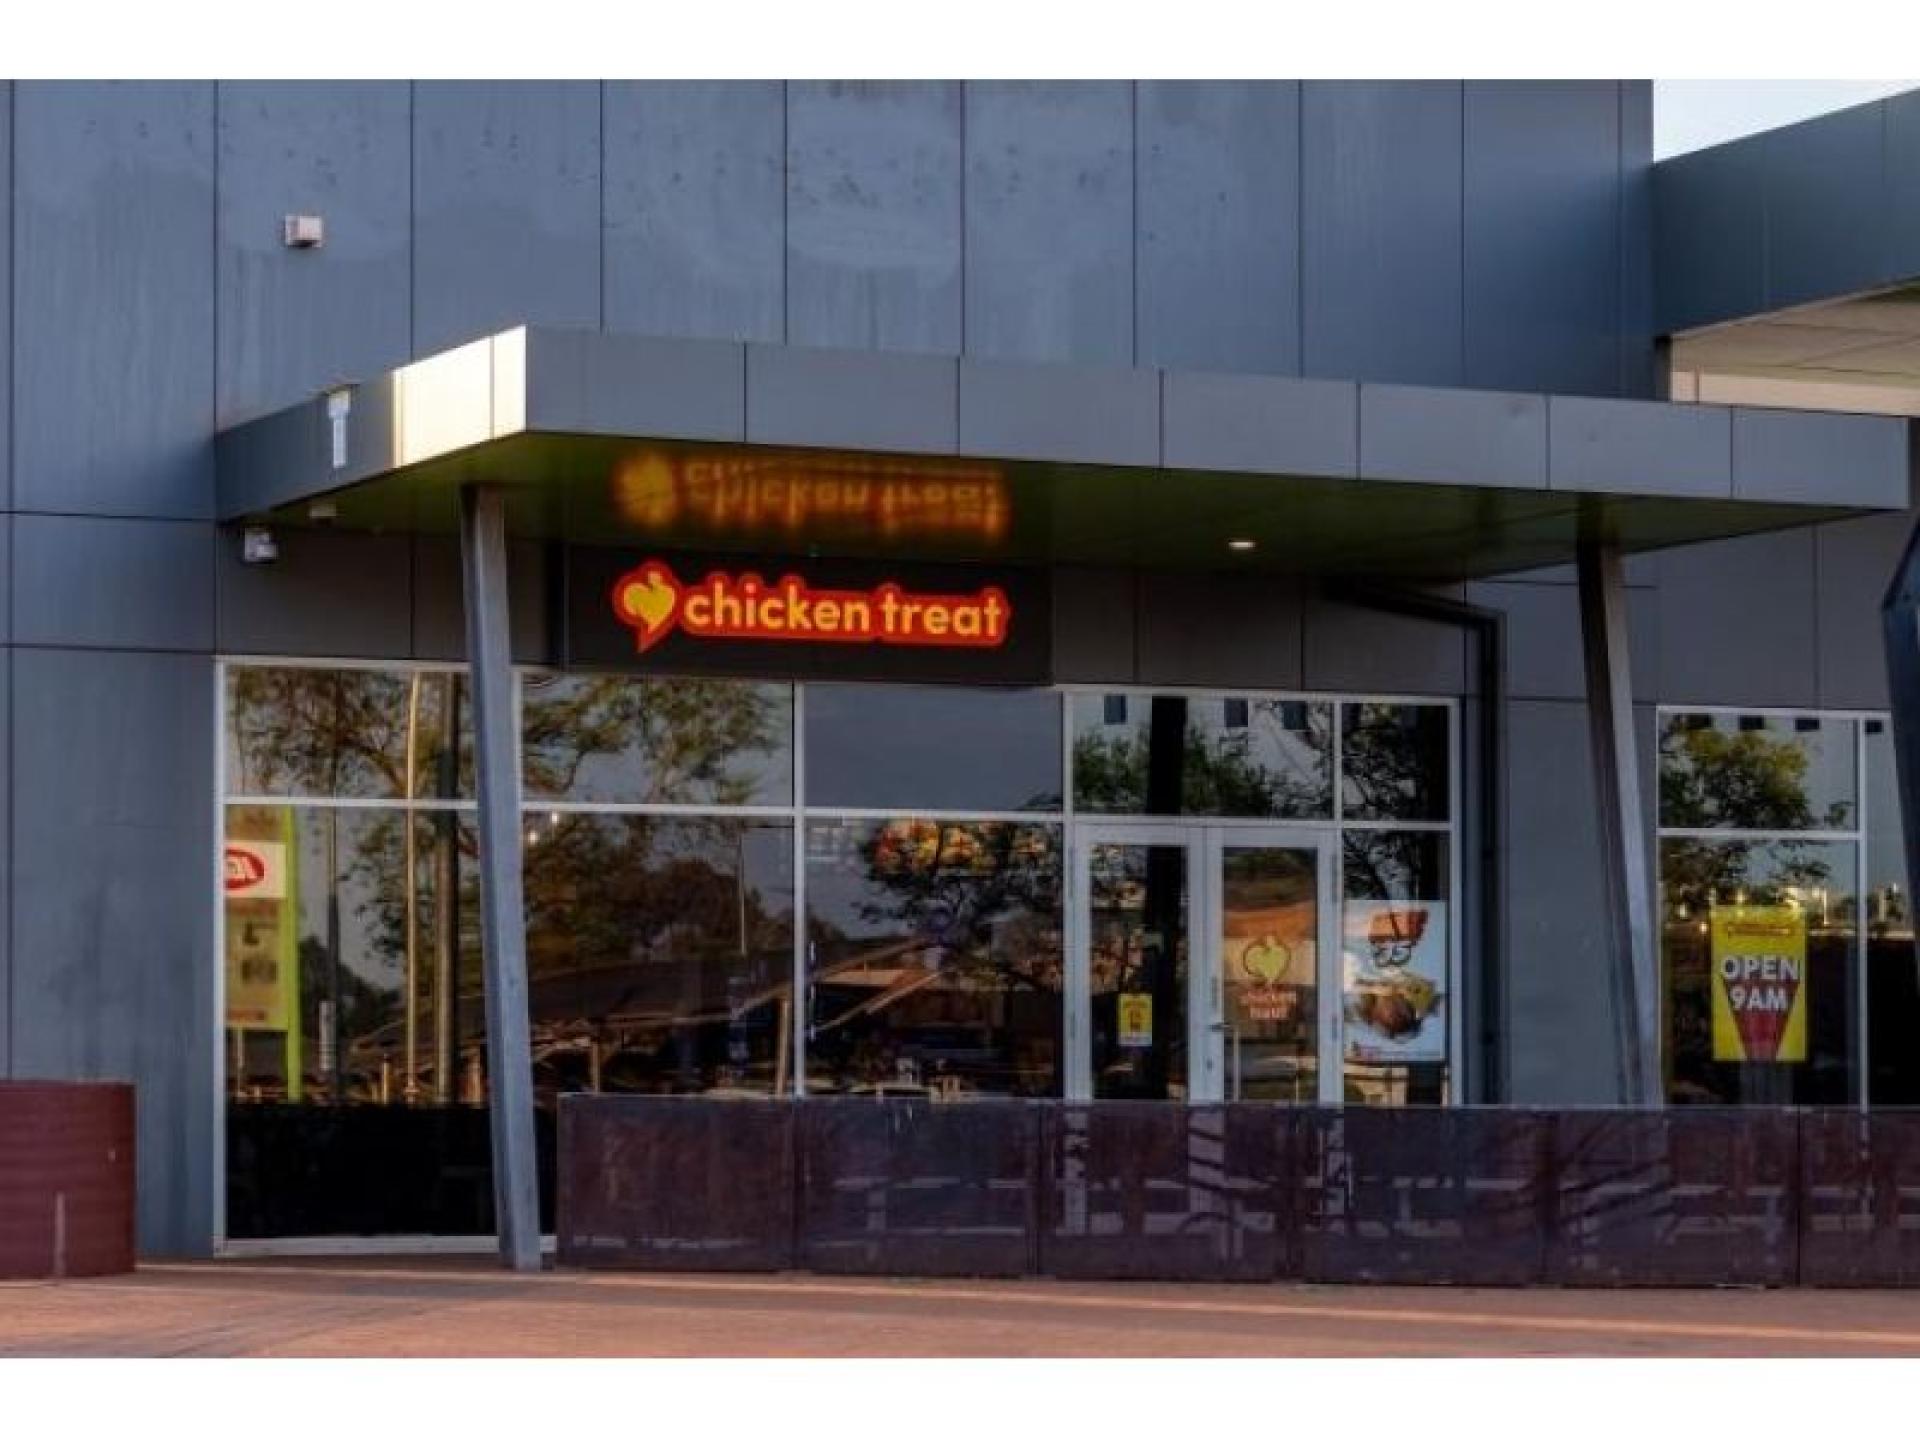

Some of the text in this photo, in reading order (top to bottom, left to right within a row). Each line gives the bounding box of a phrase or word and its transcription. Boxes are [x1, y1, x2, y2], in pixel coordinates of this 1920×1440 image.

[685, 581, 1001, 637] chicken treat
[1721, 954, 1799, 981] OPEN
[1730, 985, 1787, 1010] 9AM
